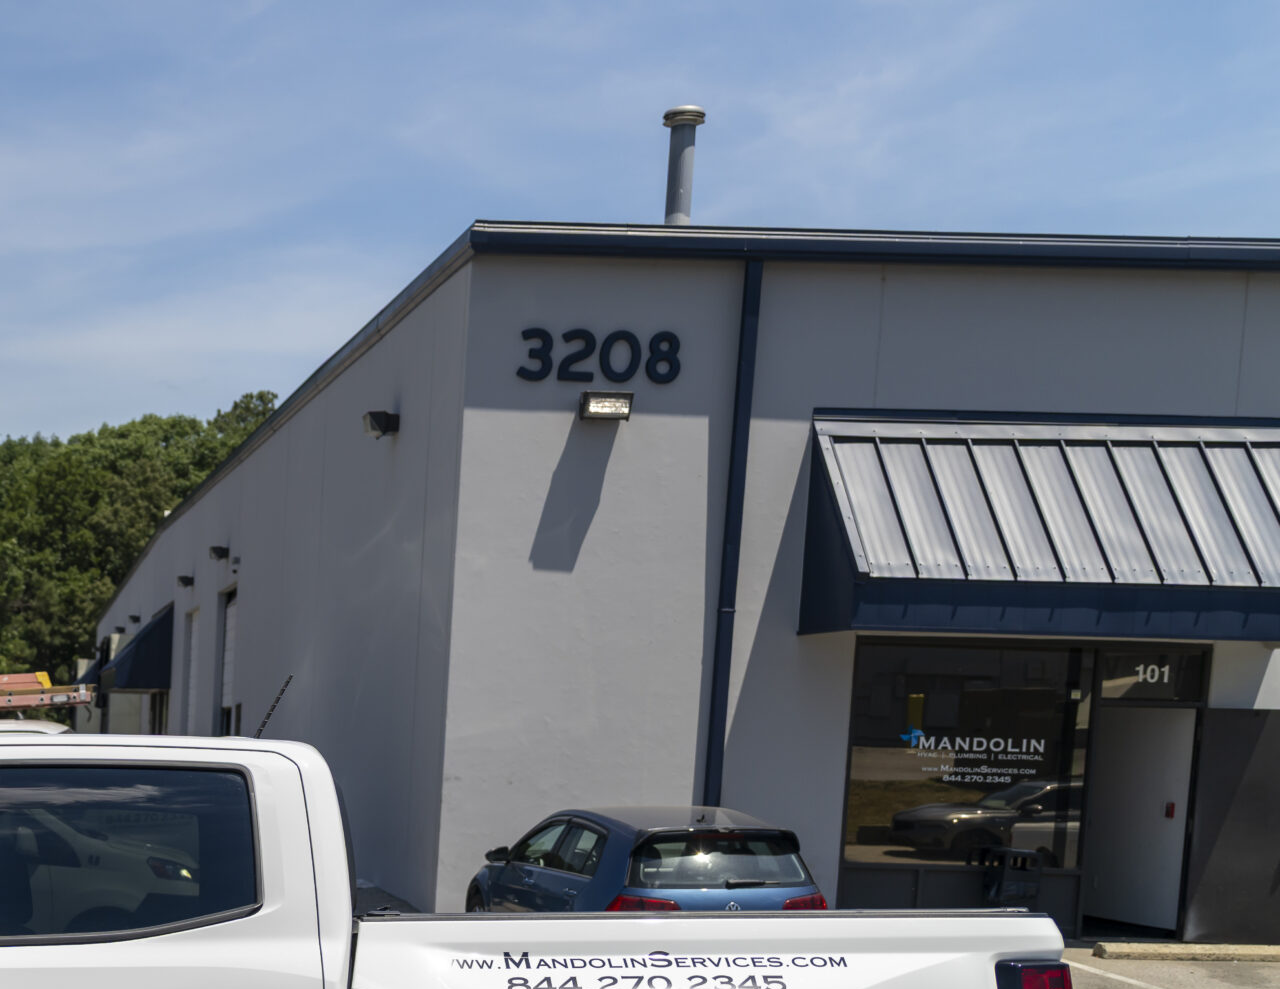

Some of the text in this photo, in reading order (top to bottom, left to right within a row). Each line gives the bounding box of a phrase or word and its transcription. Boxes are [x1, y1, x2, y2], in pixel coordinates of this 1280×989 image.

[516, 327, 681, 384] 3208
[1135, 664, 1170, 683] 101
[919, 736, 1045, 753] MANDOLIN
